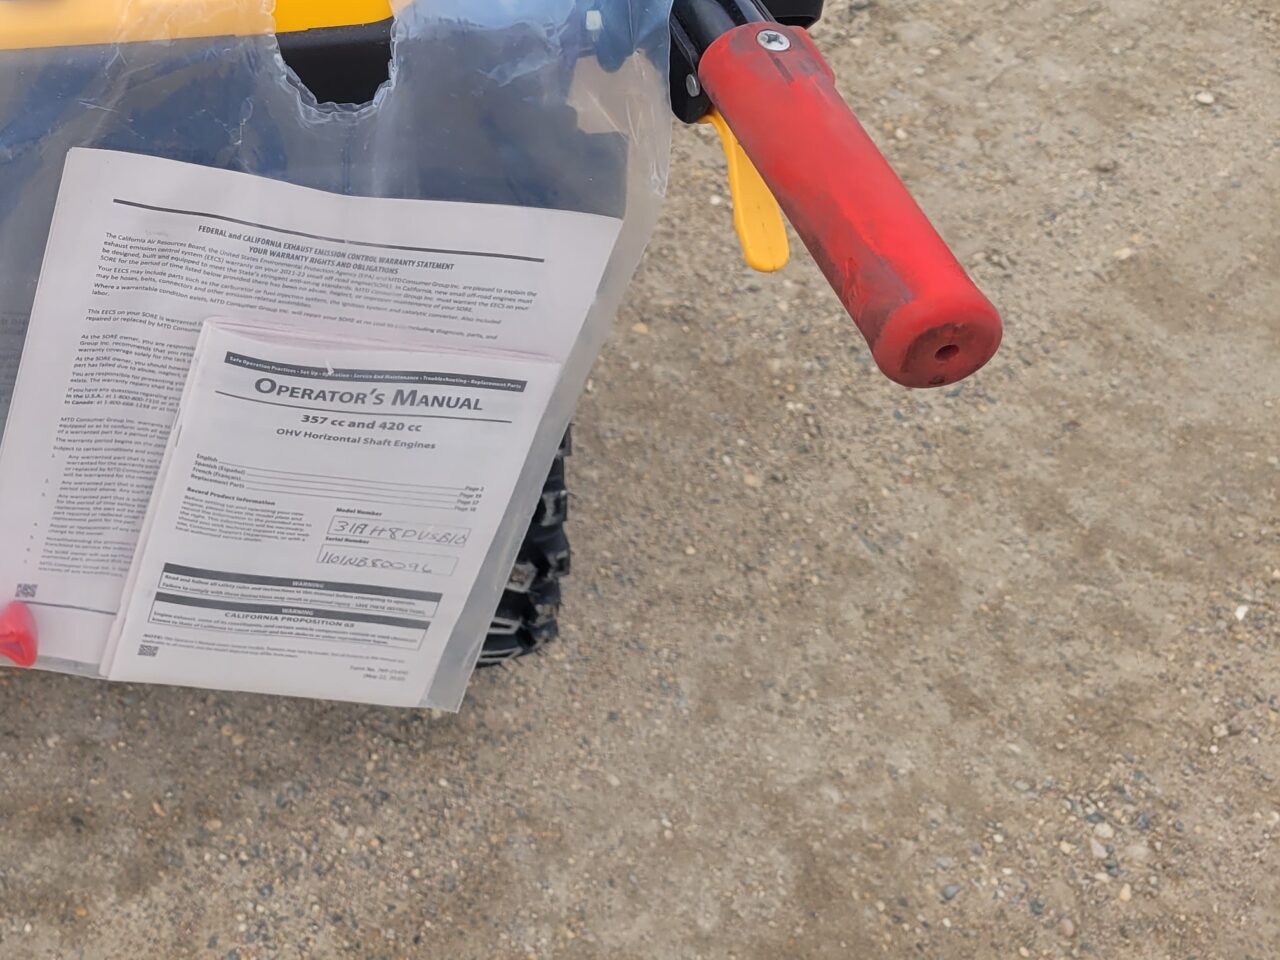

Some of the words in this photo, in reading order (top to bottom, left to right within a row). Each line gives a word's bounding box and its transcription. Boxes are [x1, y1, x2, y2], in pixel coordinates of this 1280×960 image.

[106, 232, 116, 240] The
[118, 234, 145, 243] California
[198, 225, 226, 238] FEDERAL
[228, 230, 241, 241] and
[242, 233, 281, 248] CALIFORNIA
[283, 241, 313, 254] EXHAUST
[314, 246, 346, 259] EMISSION
[347, 251, 376, 262] CONTROL
[378, 255, 416, 266] WARRANTY
[416, 259, 454, 270] STATEMENT
[249, 246, 267, 256] YOUR
[270, 250, 309, 263] WARRANTY
[309, 256, 335, 267] RIGHTS
[335, 261, 351, 270] AND
[352, 263, 399, 275] OBLIGATIONS
[255, 378, 385, 406] OPERATOR'S
[392, 390, 483, 411] MANUAL
[301, 415, 328, 426] 357
[331, 419, 346, 428] cc
[348, 419, 376, 430] and
[379, 422, 405, 432] 420
[408, 424, 422, 432] cc
[276, 428, 302, 438] OHV
[304, 431, 361, 444] Horizontal
[363, 438, 392, 447] Shaft
[393, 441, 436, 450] Engines
[196, 452, 217, 463] English
[187, 486, 209, 496] Record
[210, 491, 235, 501] Product
[224, 612, 278, 622] CALIFORNIA
[280, 617, 341, 627] PROPOSITION
